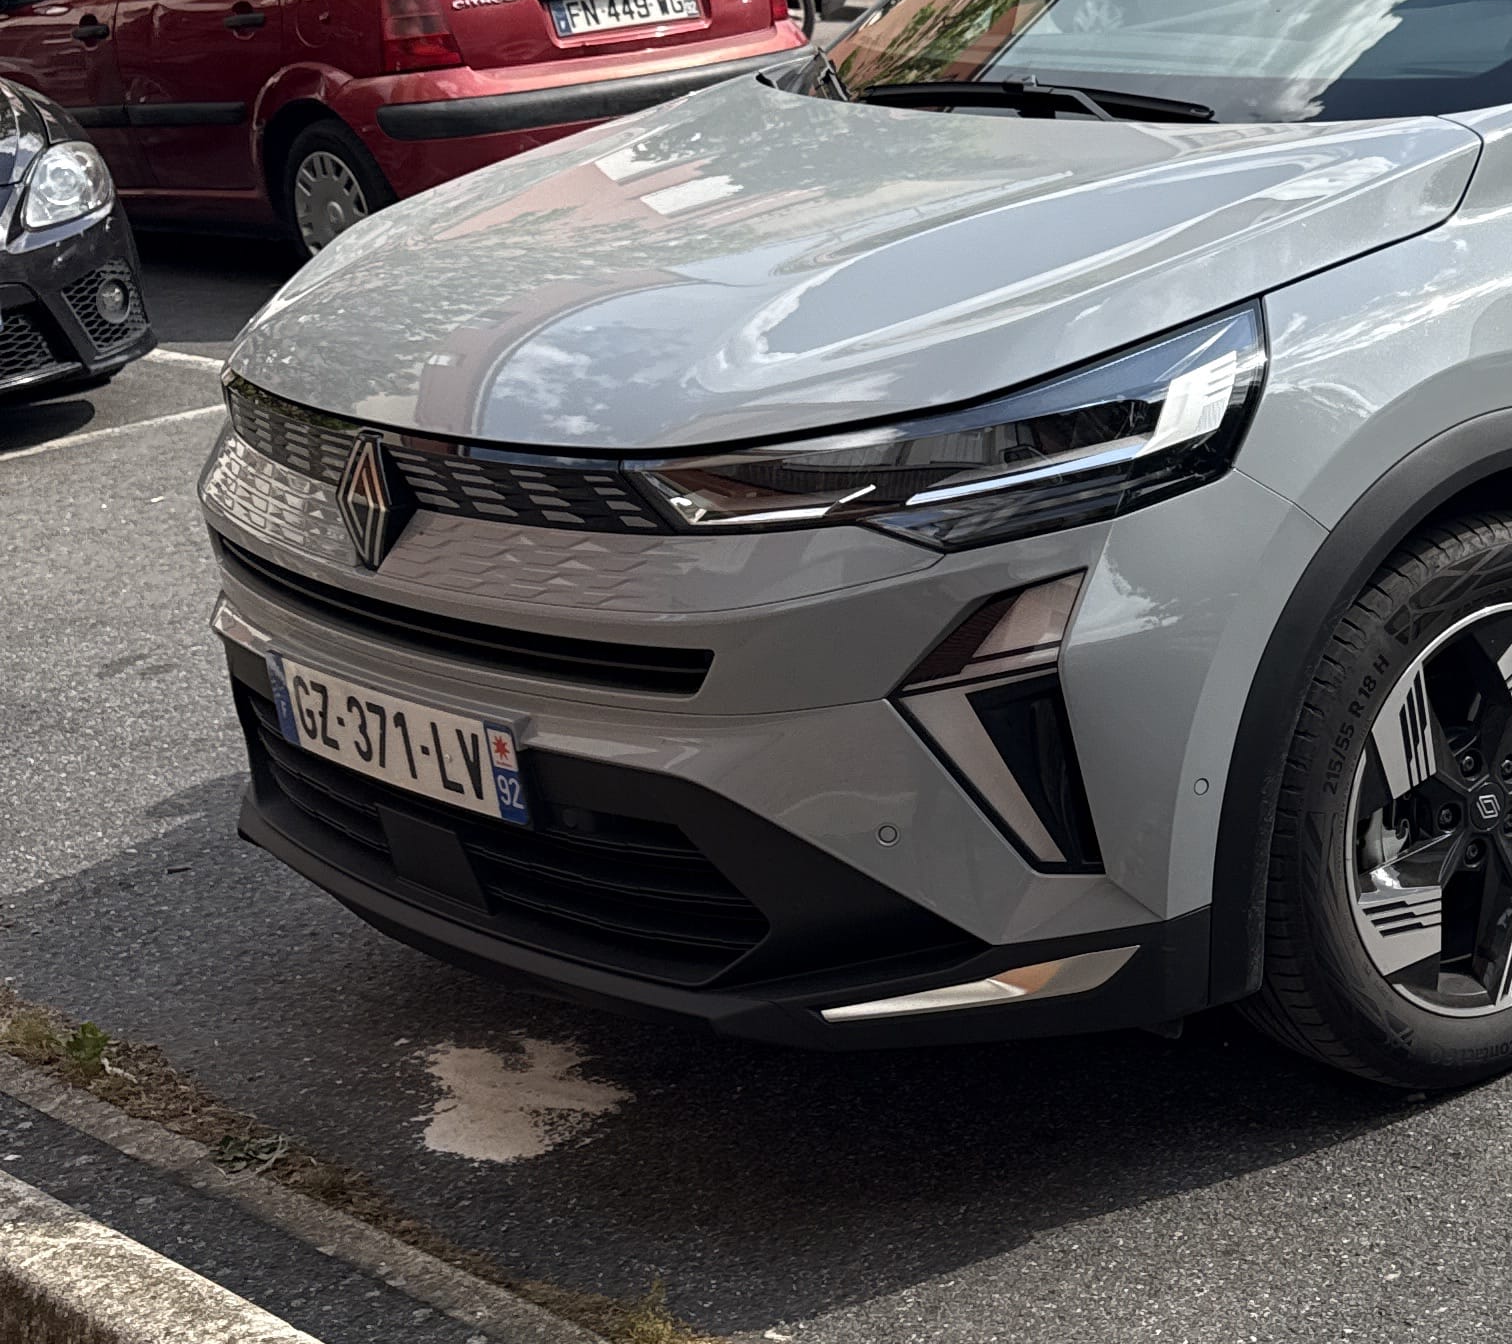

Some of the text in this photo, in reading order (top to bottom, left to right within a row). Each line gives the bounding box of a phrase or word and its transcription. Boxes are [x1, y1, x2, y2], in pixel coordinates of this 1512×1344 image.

[1348, 701, 1365, 718] R
[292, 674, 484, 801] GZ-371-LV
[497, 774, 525, 810] 92
